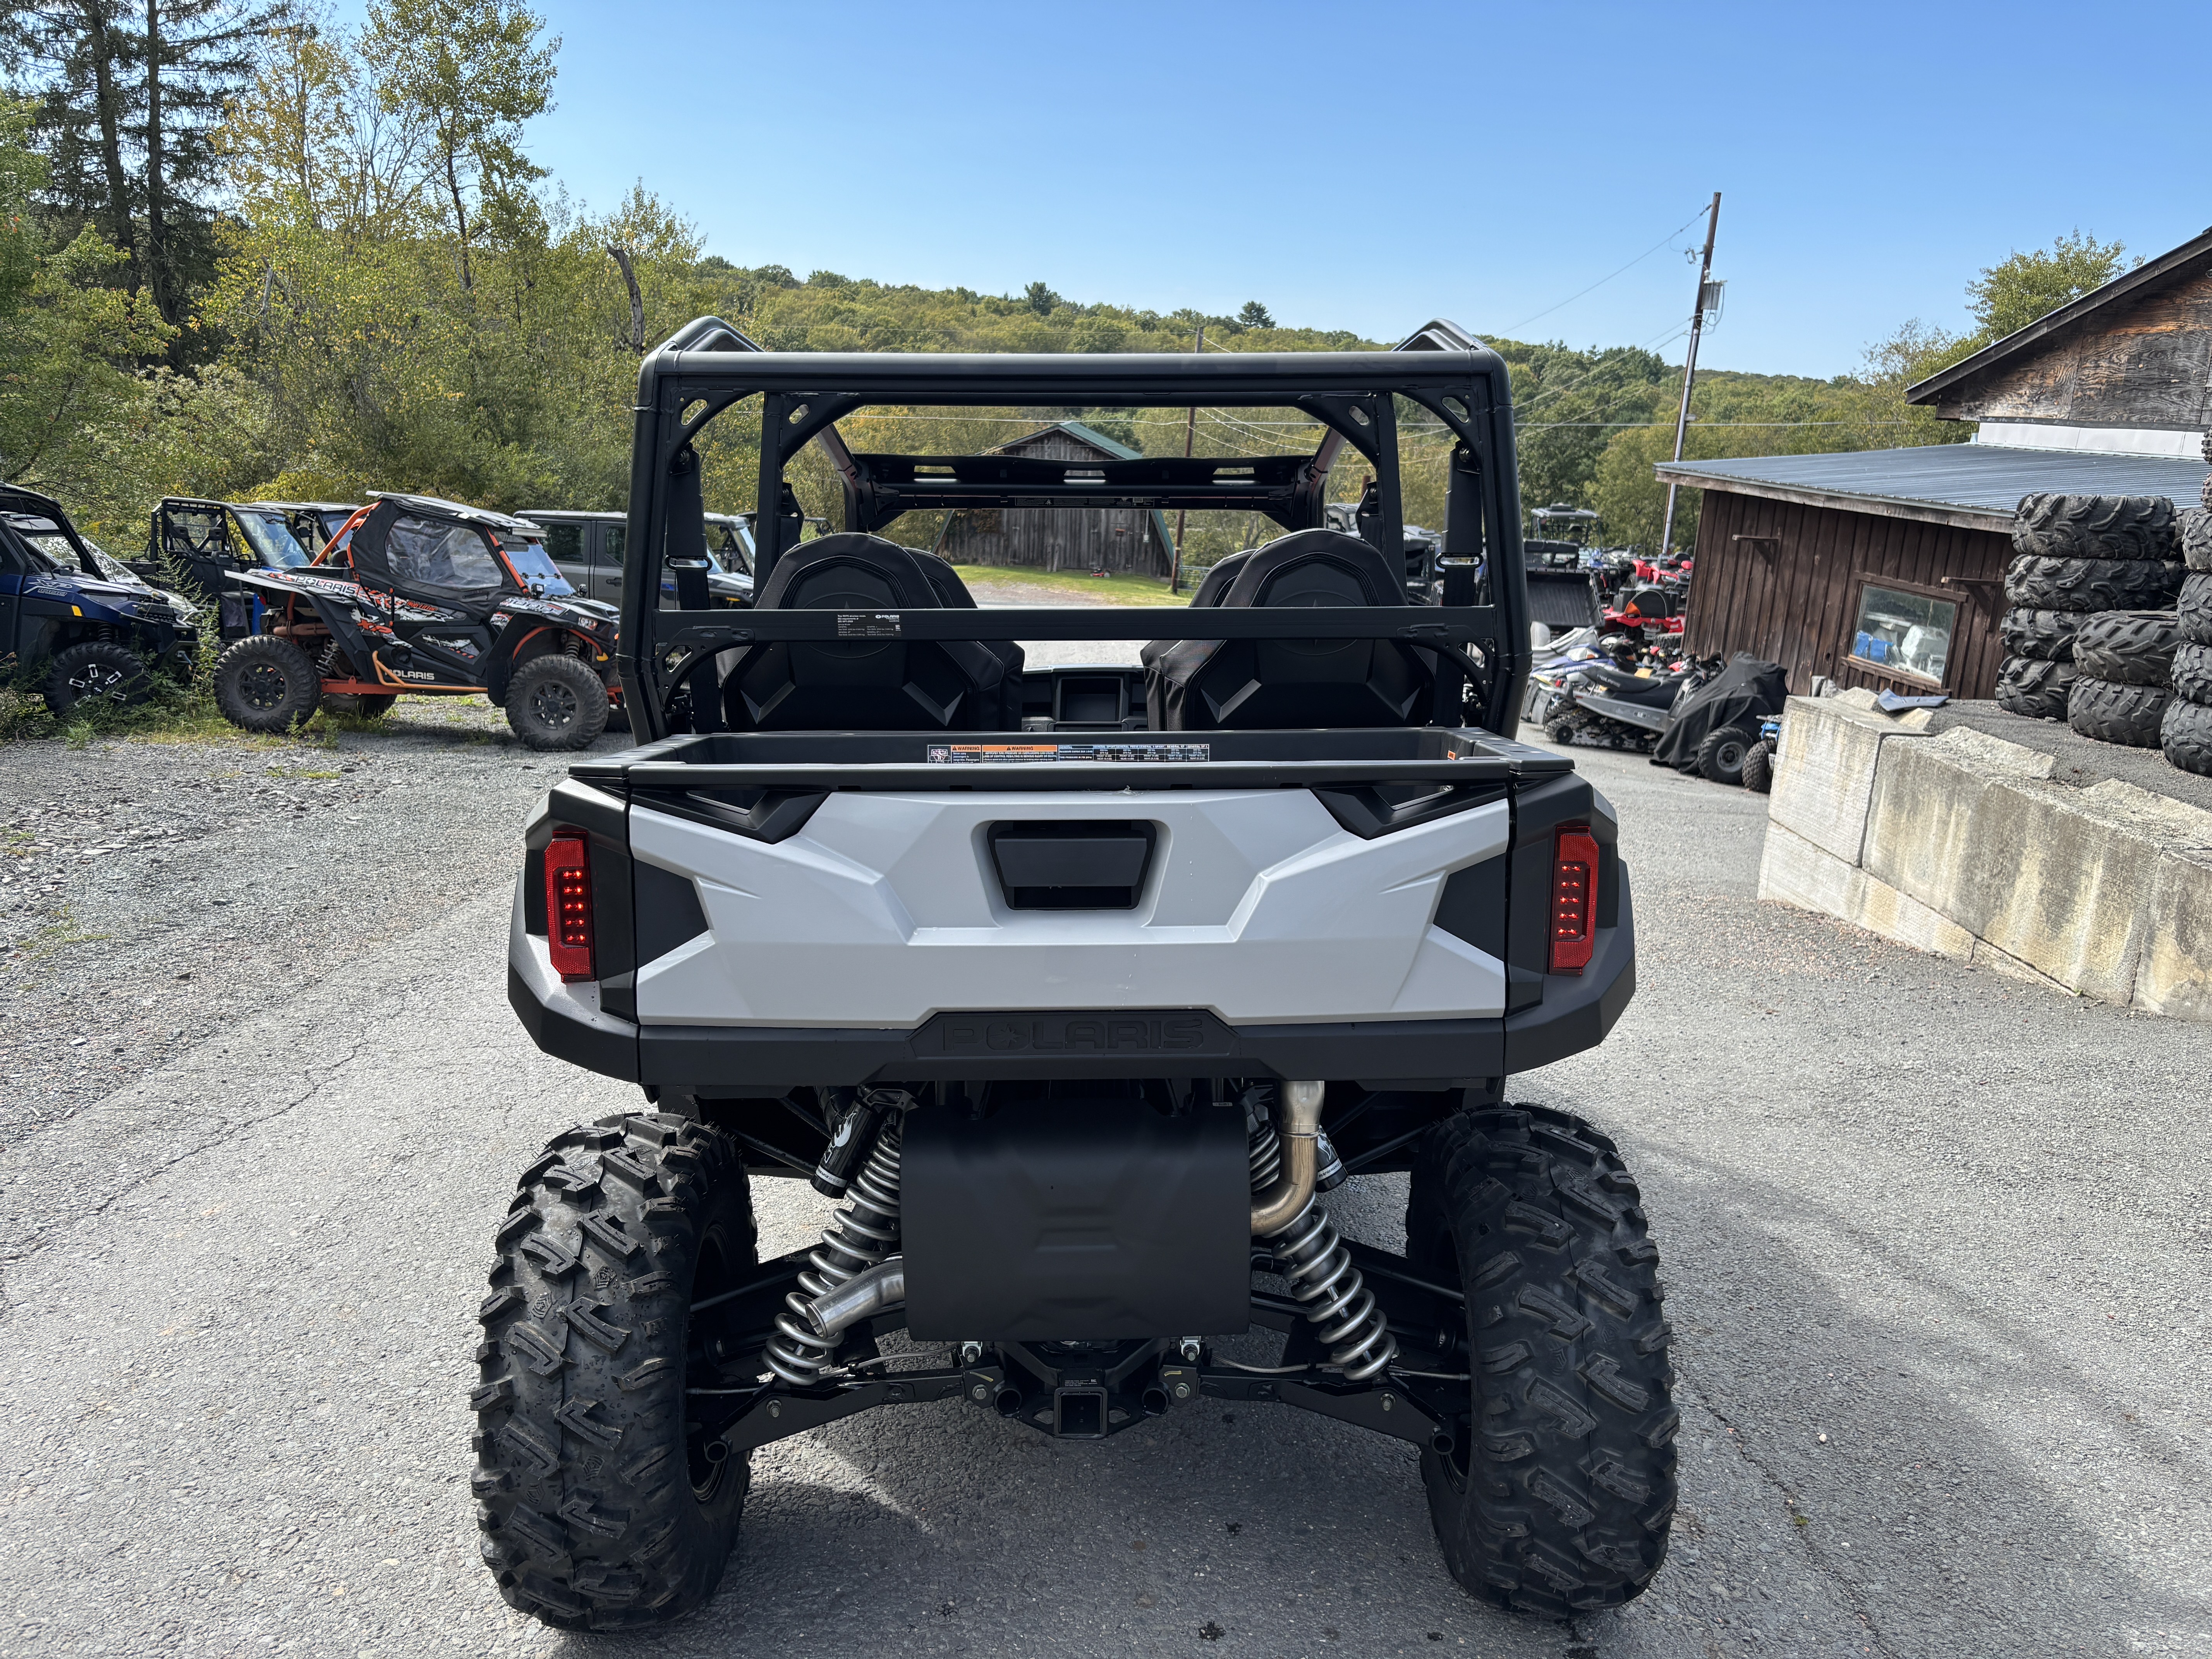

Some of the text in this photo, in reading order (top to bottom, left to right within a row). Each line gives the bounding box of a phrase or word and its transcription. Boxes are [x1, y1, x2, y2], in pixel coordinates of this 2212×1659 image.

[27, 579, 73, 589] XP
[295, 576, 356, 594] POLARIS
[944, 1020, 1203, 1051] POLARIS
